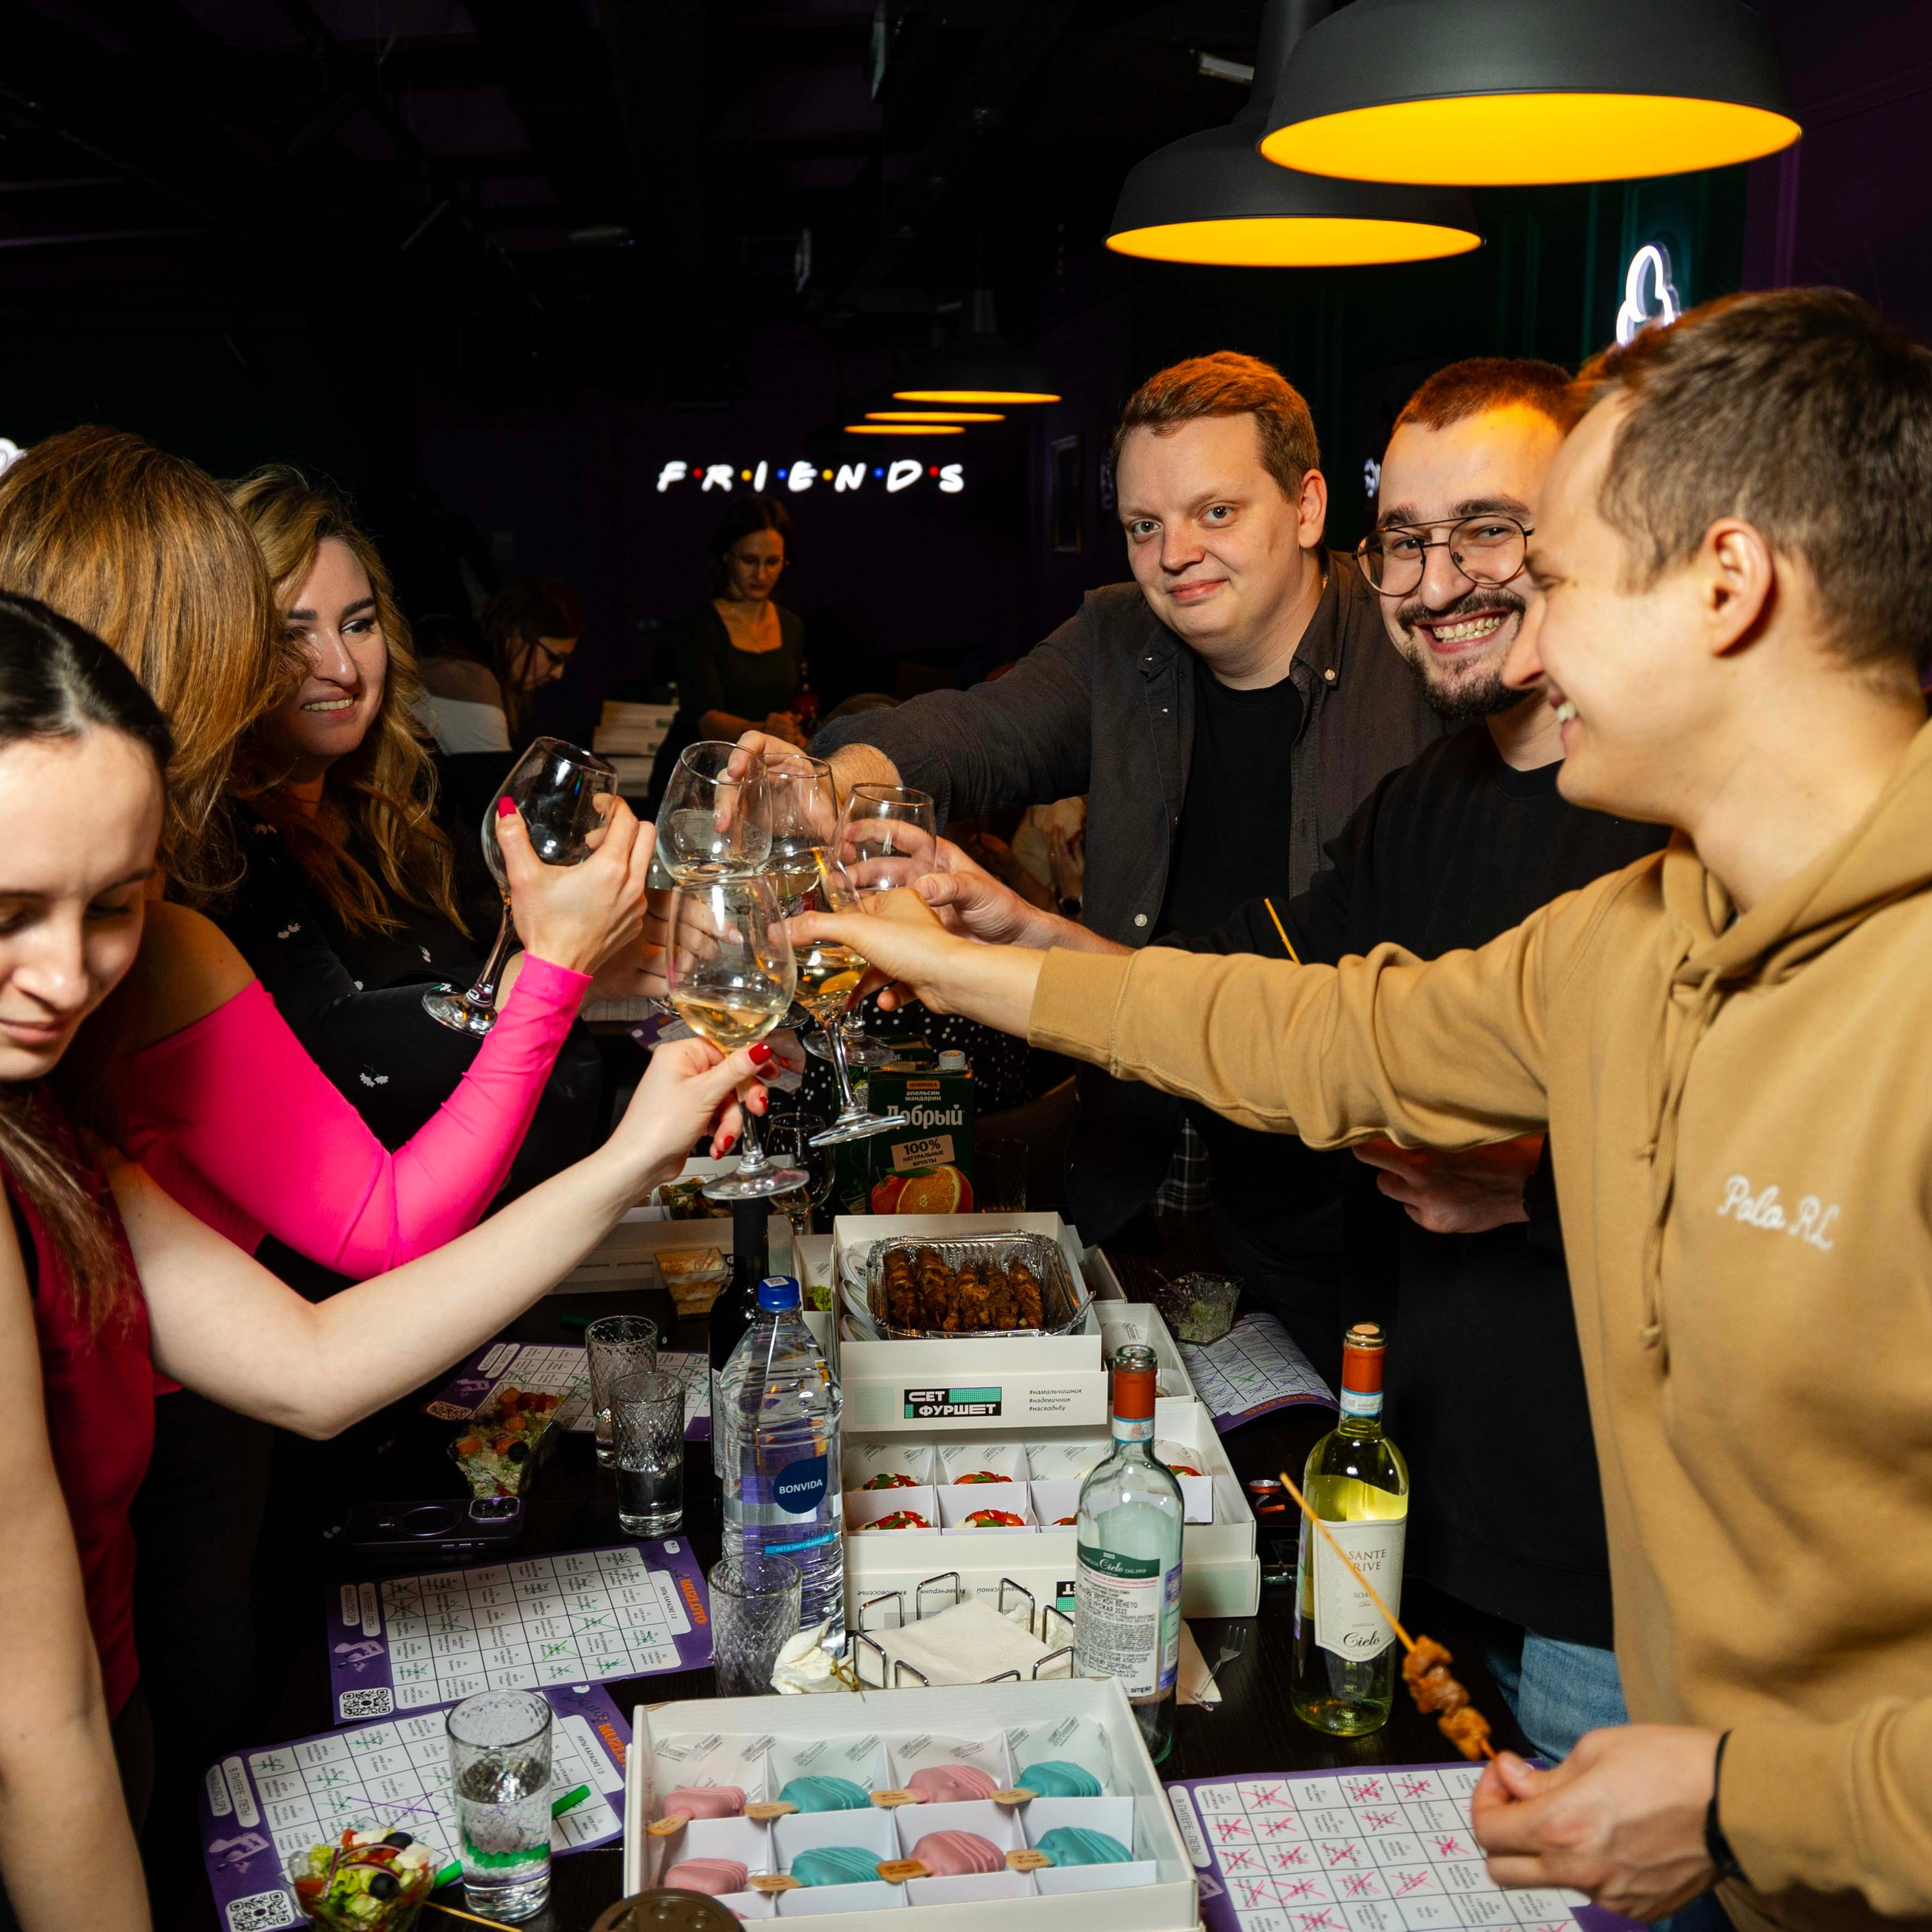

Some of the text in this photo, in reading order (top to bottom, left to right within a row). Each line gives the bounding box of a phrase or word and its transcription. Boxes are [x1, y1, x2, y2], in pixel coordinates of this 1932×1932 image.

[903, 1138, 941, 1155] 100%
[903, 1149, 944, 1162] НАТУРАЛЬНЫЕ
[912, 1158, 937, 1167] ФРУКТЫ
[1717, 1174, 1786, 1230] Polo
[908, 1390, 945, 1402] СЕТ
[918, 1403, 996, 1416] ФУРШЕТ
[779, 1478, 823, 1494] BONVIDA
[1349, 1549, 1387, 1560] SANTE
[1099, 1558, 1124, 1572] Cielo
[1354, 1561, 1382, 1571] RIVE
[663, 1595, 676, 1614] КАРАОКЕ
[679, 1578, 708, 1625] MUZLOTO
[1343, 1630, 1380, 1648] Cielo
[1130, 1685, 1152, 1694] simple
[577, 1735, 589, 1748] ХИТЫ
[583, 1746, 600, 1768] КАРАОКЕ
[228, 1770, 246, 1796] ПИТЕРЕ
[234, 1798, 253, 1818] ПЕТЬ!
[1175, 1804, 1195, 1830] ПИТЕРЕ
[1185, 1835, 1204, 1855] ПЕТЬ!
